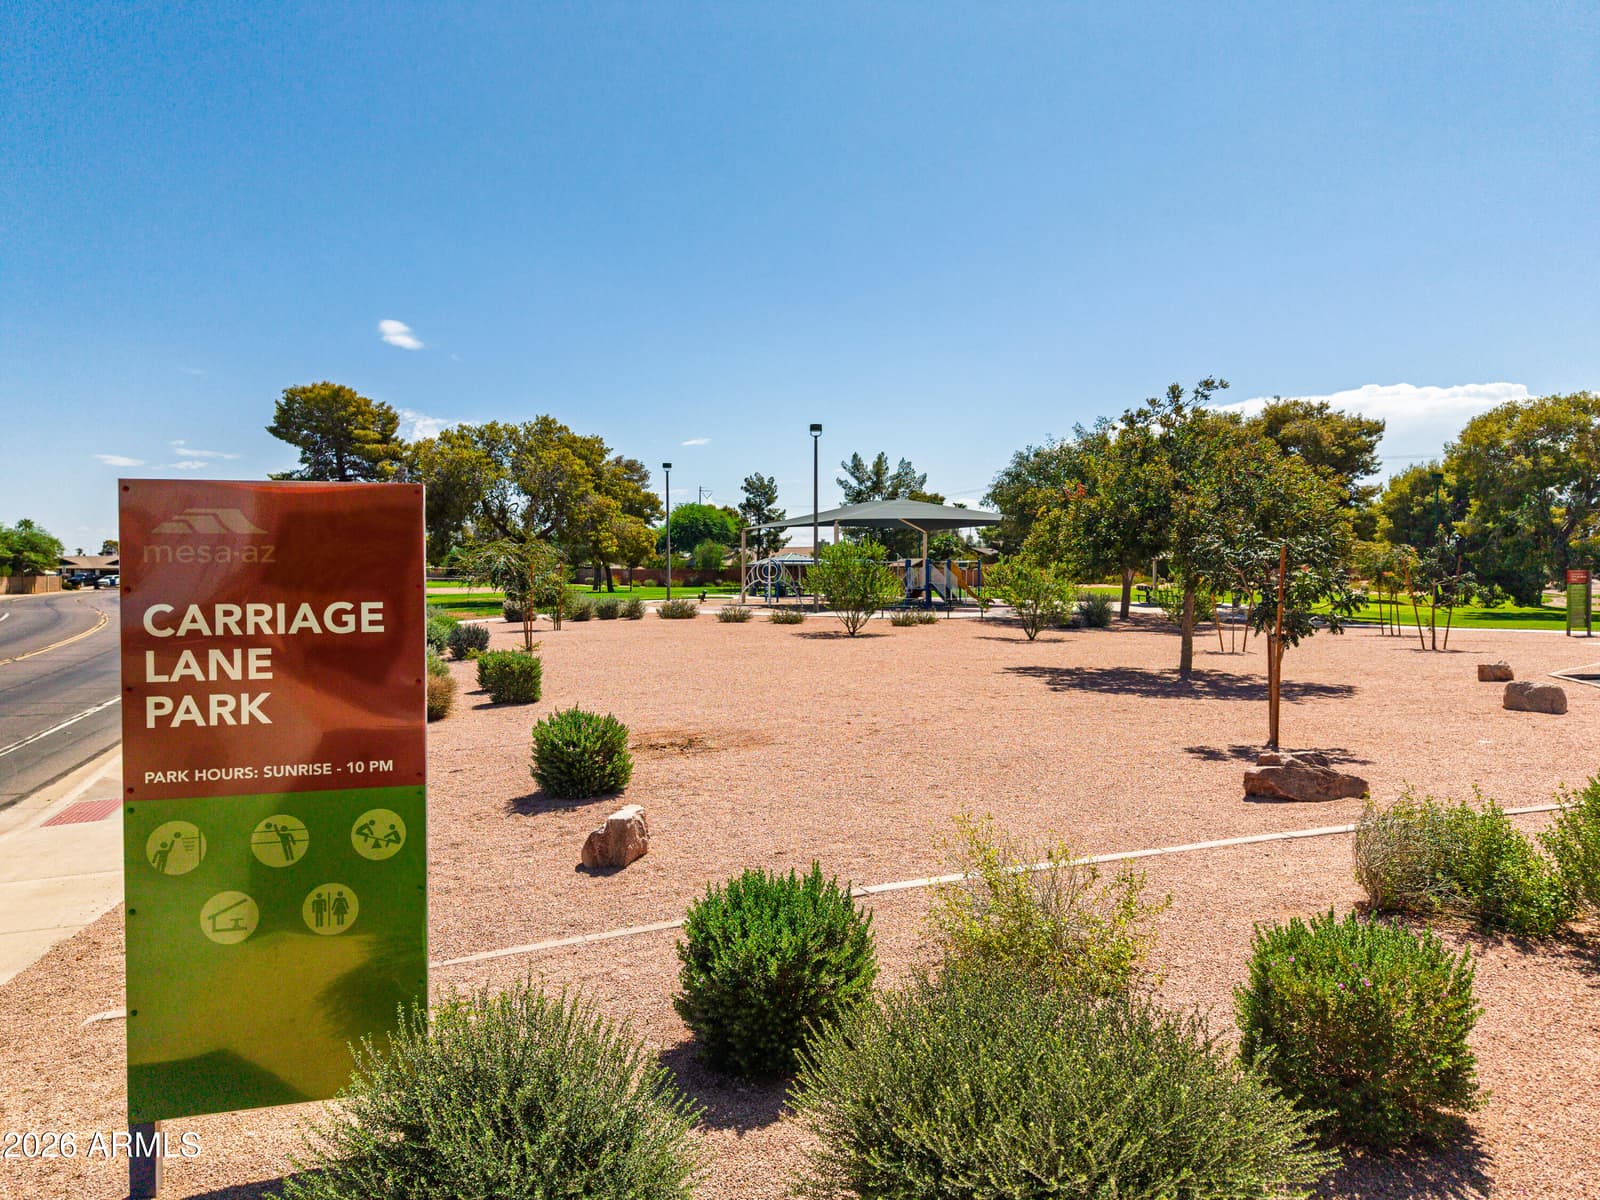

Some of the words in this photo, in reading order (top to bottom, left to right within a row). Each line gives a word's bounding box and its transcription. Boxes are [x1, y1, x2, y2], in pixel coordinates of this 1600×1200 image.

[143, 601, 385, 638] CARRIAGE
[146, 648, 273, 683] LANE
[146, 692, 272, 728] PARK
[145, 770, 189, 784] PARK
[195, 766, 258, 781] HOURS:
[264, 763, 332, 778] SUNRISE
[347, 762, 364, 773] 10
[369, 760, 393, 772] PM
